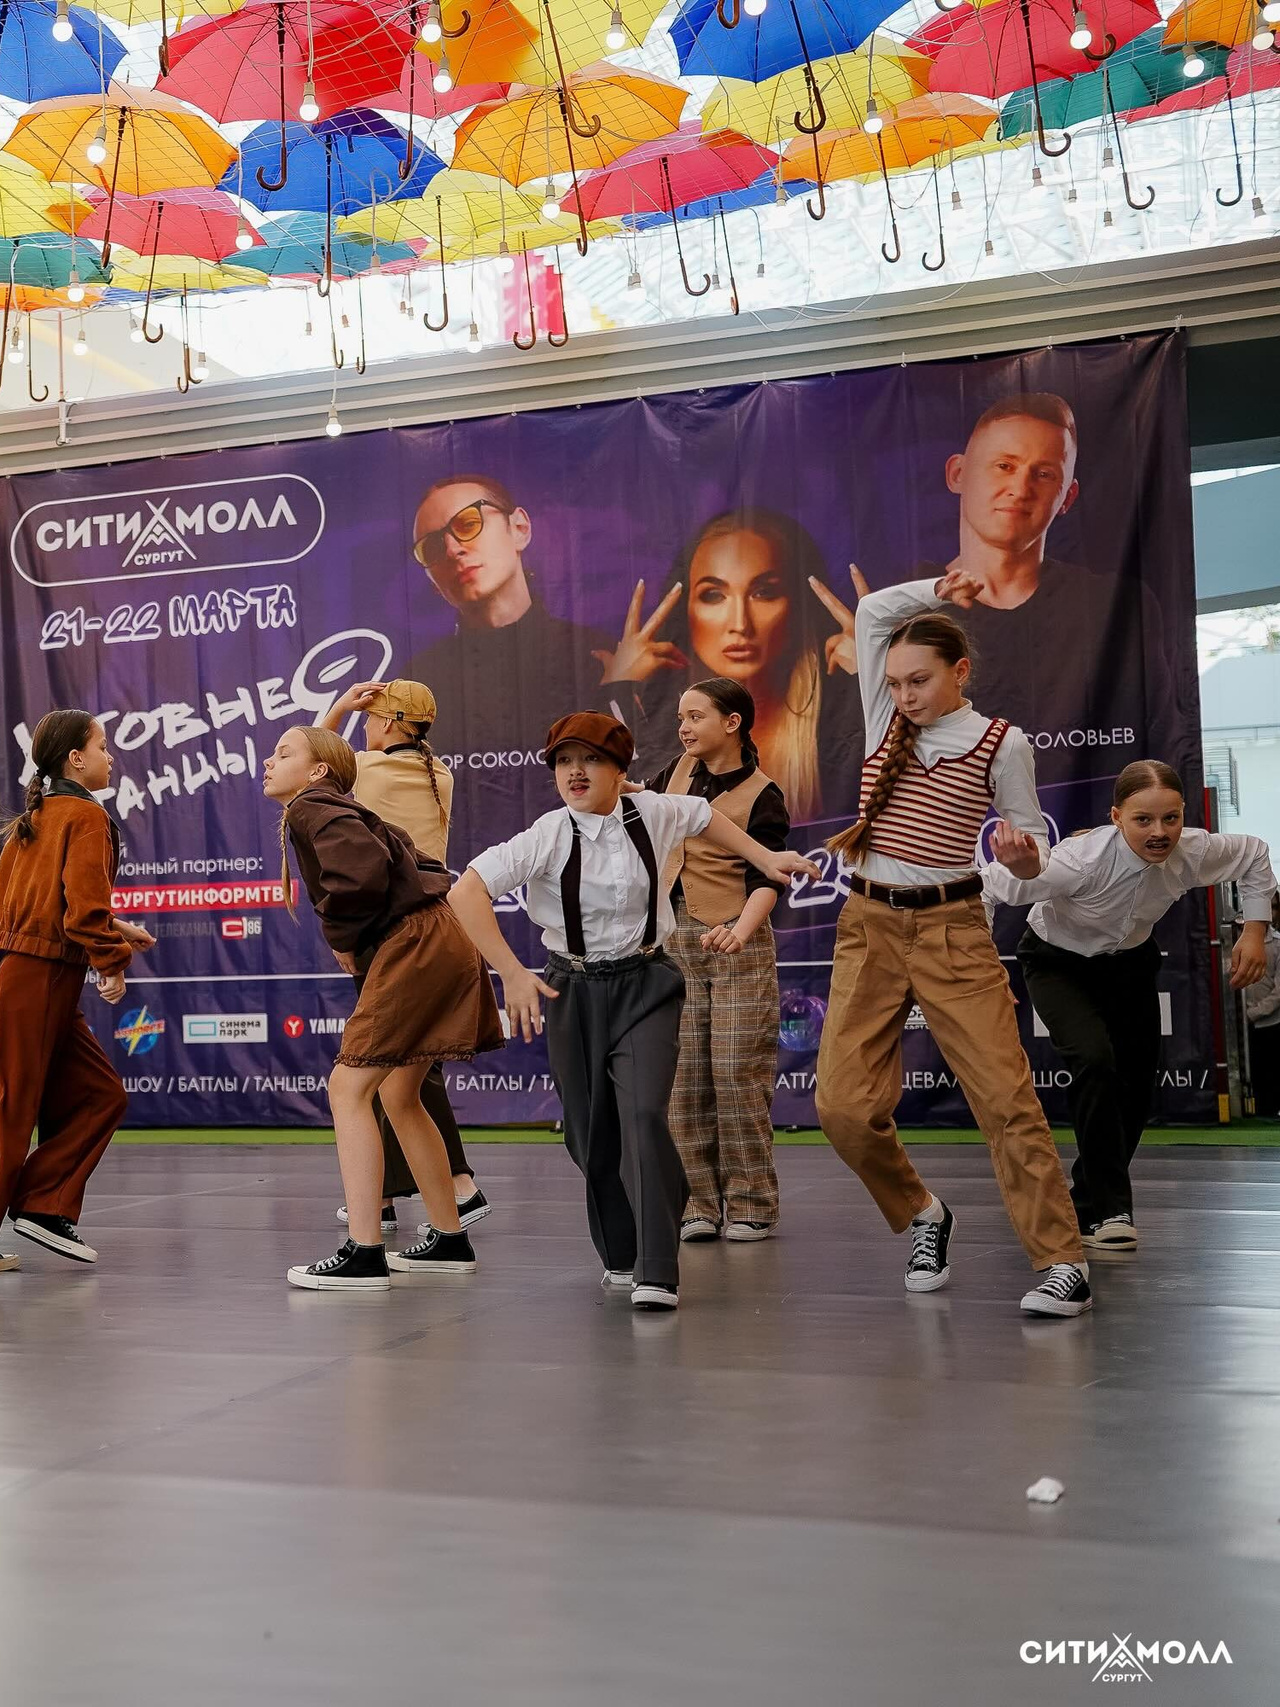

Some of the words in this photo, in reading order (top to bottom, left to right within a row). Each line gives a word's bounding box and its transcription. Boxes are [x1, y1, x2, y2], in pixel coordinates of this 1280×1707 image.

[36, 511, 142, 552] СИТИ
[175, 494, 297, 536] МОЛЛ
[134, 550, 184, 566] СУРГУТ
[39, 601, 162, 650] 21-22
[169, 584, 297, 637] МАРТА
[468, 749, 547, 768] СОКОЛО
[183, 856, 263, 875] партнер:
[220, 1019, 261, 1028] синема
[220, 1028, 248, 1038] парк
[309, 1018, 346, 1034] YAMA
[122, 1076, 163, 1093] ШОУ
[178, 1075, 238, 1093] БАТТЛЫ
[254, 1074, 329, 1093] ТАНЦЕВА
[456, 1074, 523, 1091] БАТТЛЫ
